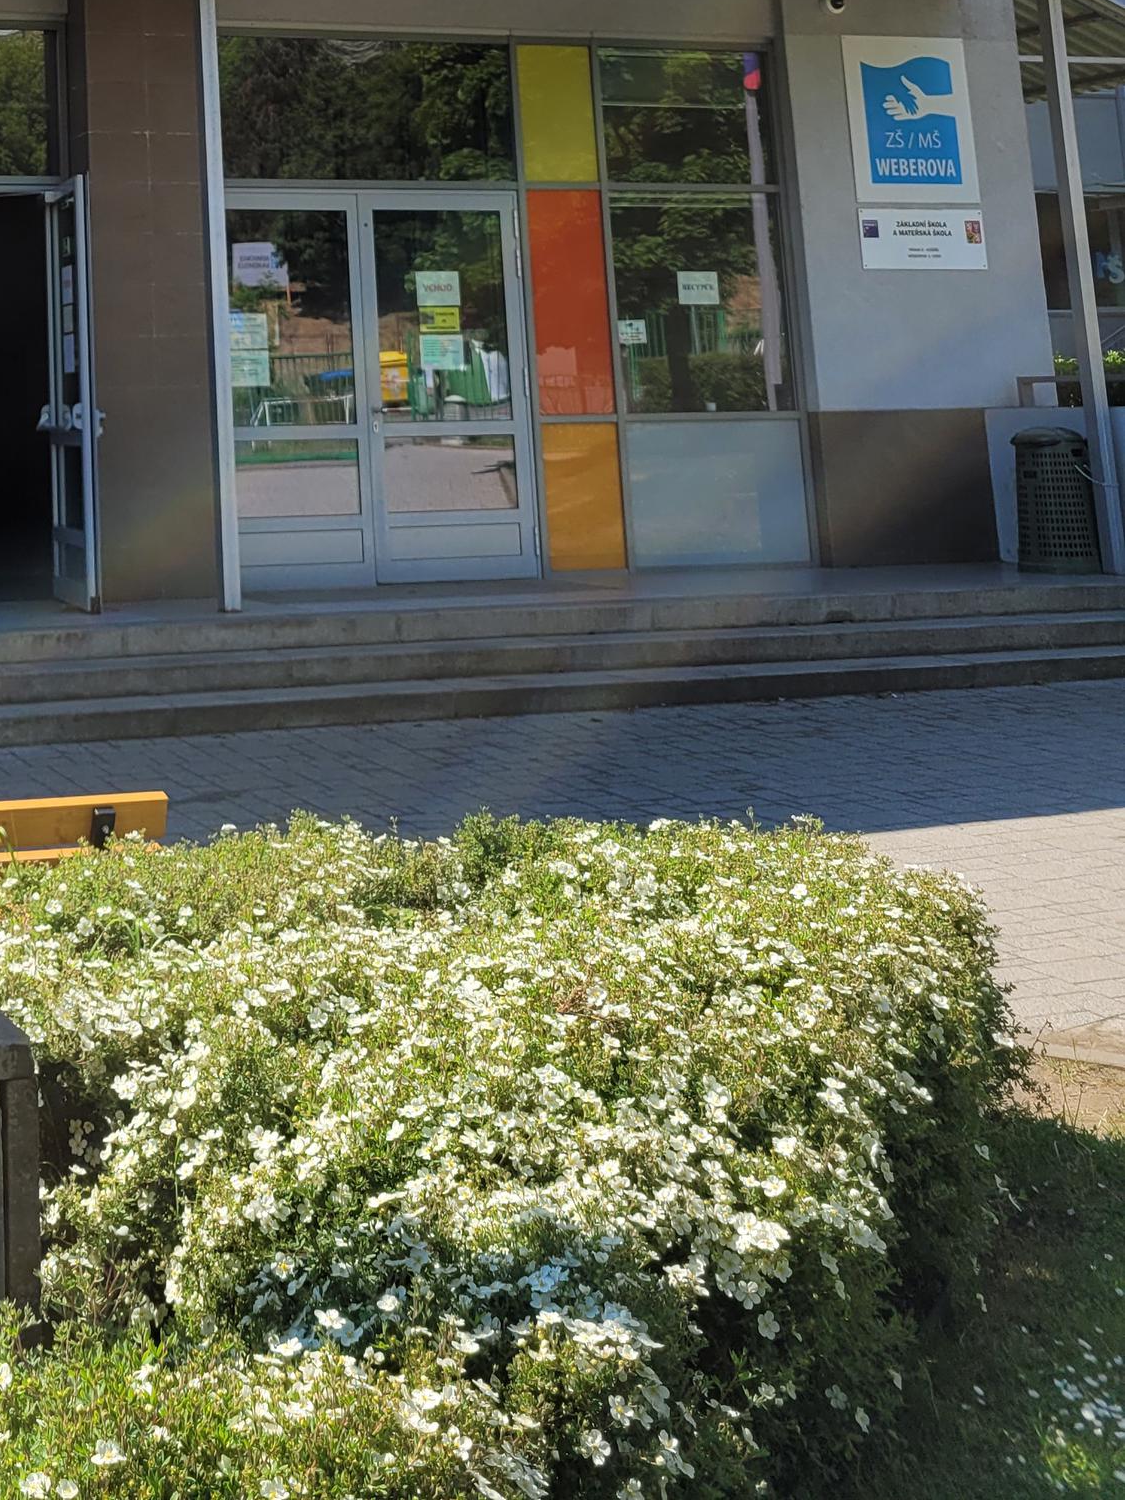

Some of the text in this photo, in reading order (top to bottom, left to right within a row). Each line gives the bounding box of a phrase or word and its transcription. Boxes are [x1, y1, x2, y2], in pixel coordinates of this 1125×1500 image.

[885, 129, 904, 148] ZŠ
[918, 130, 942, 148] MŠ
[875, 157, 956, 177] WEBEROVA
[896, 219, 947, 228] ZÁKLADNÍ ŠKOLA
[899, 229, 931, 237] MATEŘSKÁ
[933, 229, 952, 237] ŠKOLA
[422, 283, 453, 292] VCHOD
